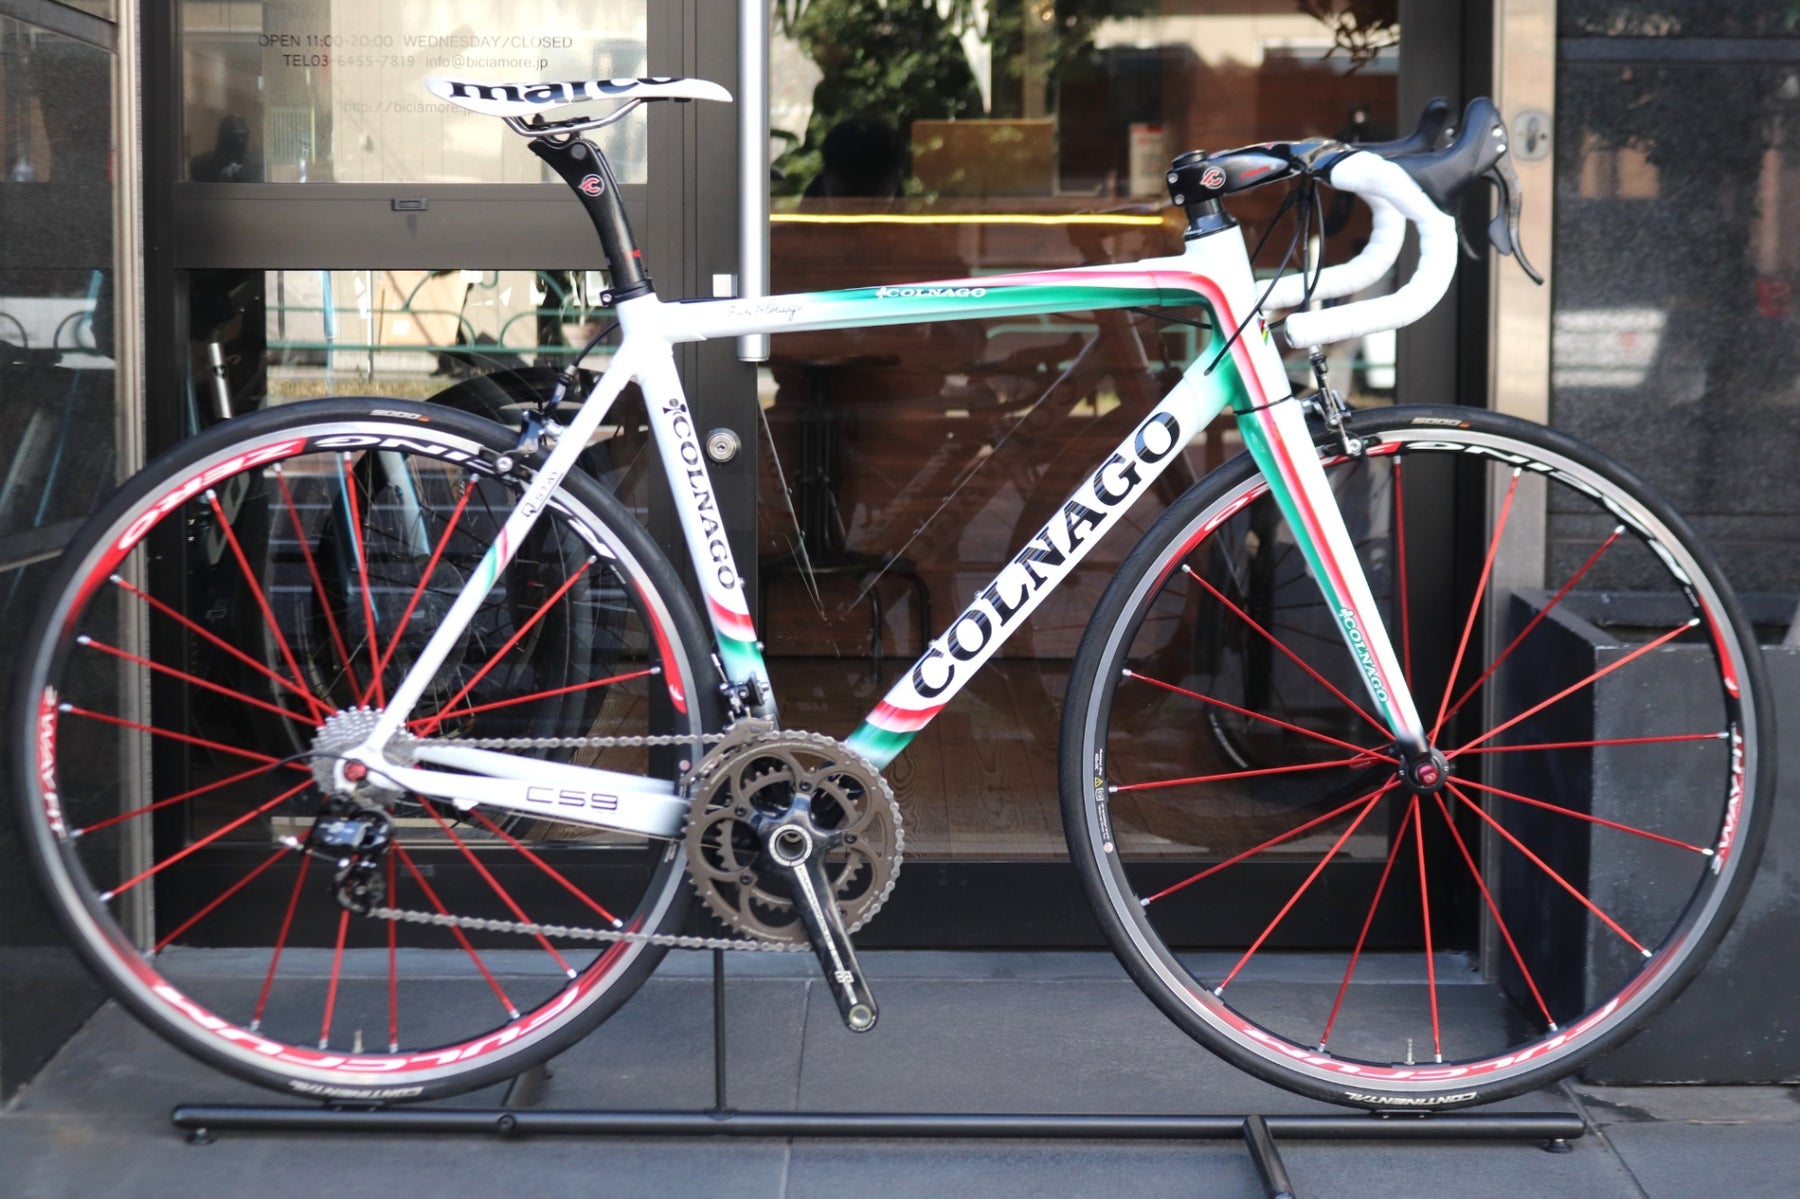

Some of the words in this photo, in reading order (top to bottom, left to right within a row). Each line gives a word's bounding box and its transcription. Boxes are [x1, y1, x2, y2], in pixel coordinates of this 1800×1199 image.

[258, 34, 299, 47] OPEN
[306, 34, 393, 48] 11:00-20:00
[403, 35, 573, 49] WEDNESDAY/CLOSED
[425, 55, 548, 71] info@biciamore.jp
[886, 287, 987, 299] COLNAGO
[117, 440, 301, 550] ZERO
[673, 415, 736, 590] COLNAGO
[912, 411, 1181, 699] COLNAGO
[1344, 617, 1388, 703] COLNAGO
[526, 786, 619, 811] C59
[153, 984, 580, 1073] FULCRUM
[1242, 997, 1621, 1082] FULCRUM
[289, 1079, 423, 1100] CONTINENTAL
[1344, 1091, 1478, 1105] CONTINENTAL
